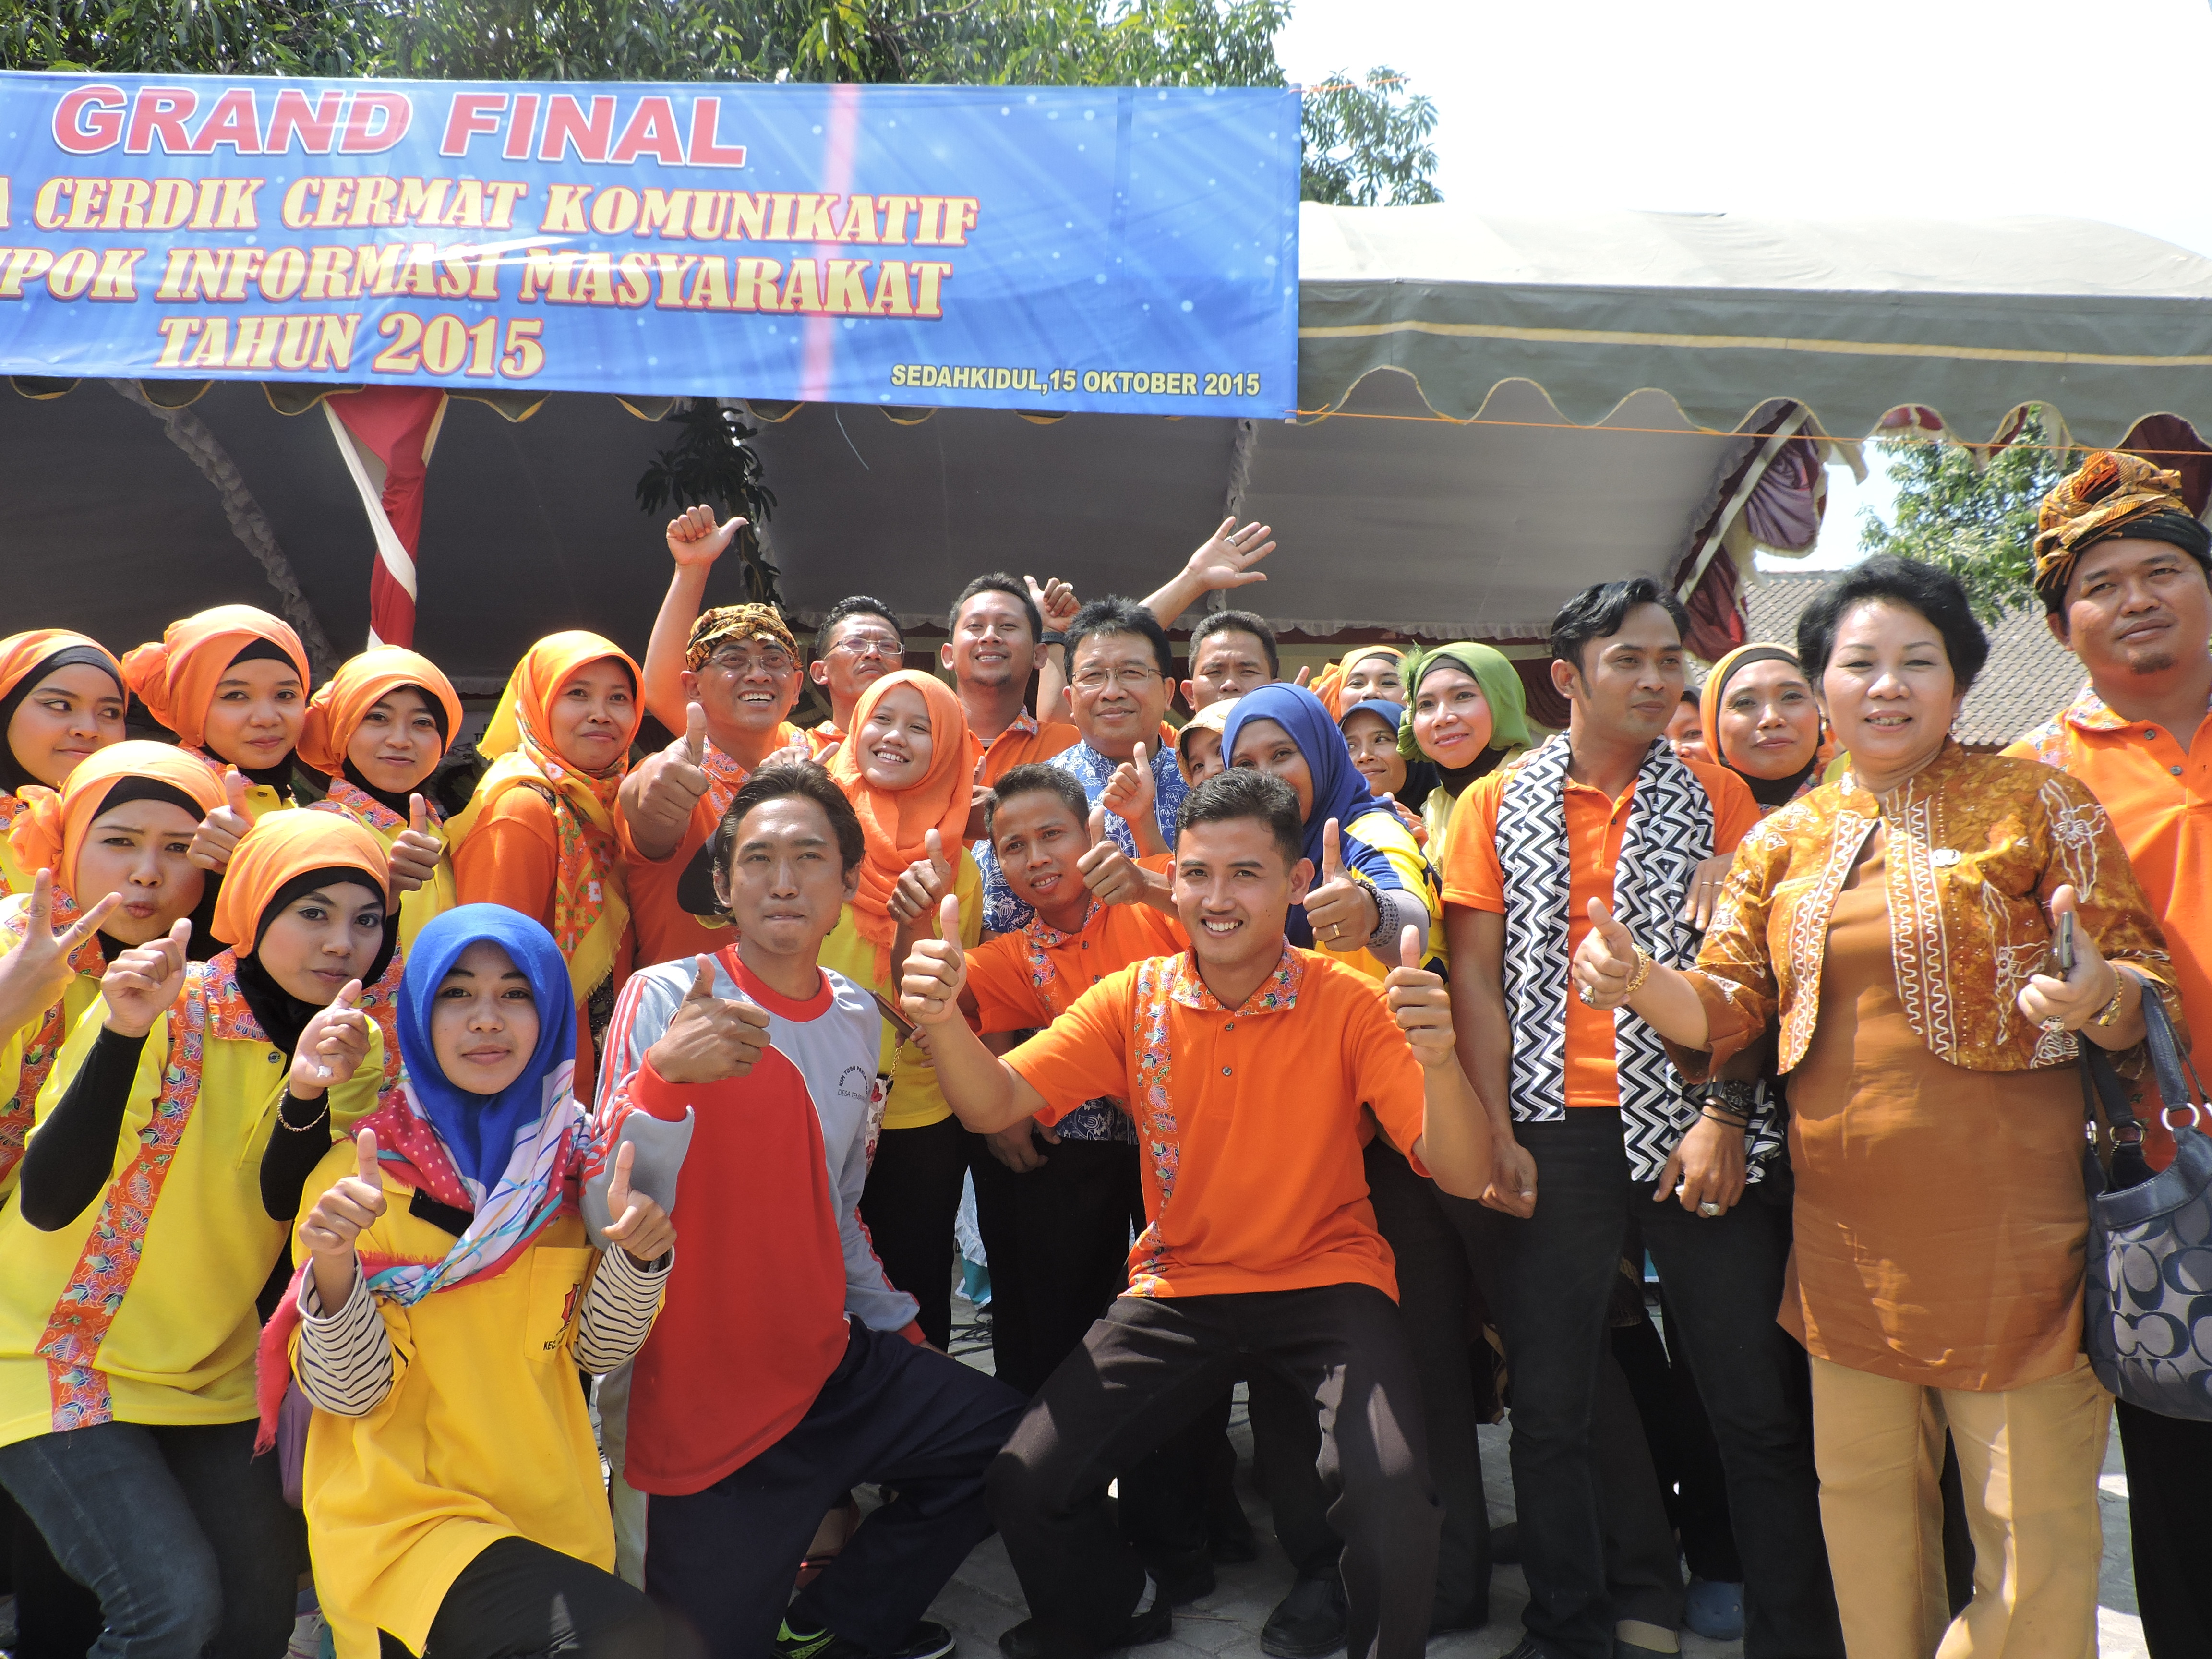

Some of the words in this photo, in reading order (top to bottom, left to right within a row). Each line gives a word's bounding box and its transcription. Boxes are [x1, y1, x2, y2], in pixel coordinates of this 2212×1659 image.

[52, 84, 413, 156] GRAND
[439, 92, 747, 168] FINAL
[33, 176, 266, 231] CERDIK
[282, 176, 529, 232] CERMAT
[538, 184, 981, 247] KOMUNIKATIF
[0, 246, 147, 302] POK
[154, 242, 504, 303] INFORMASI
[518, 247, 953, 320] MASYARAKAT
[154, 313, 363, 371] TAHUN
[371, 312, 545, 379] 2015
[1082, 370, 1198, 396] OKTOBER
[1203, 372, 1261, 397] 2015
[838, 1089, 851, 1097] DESA
